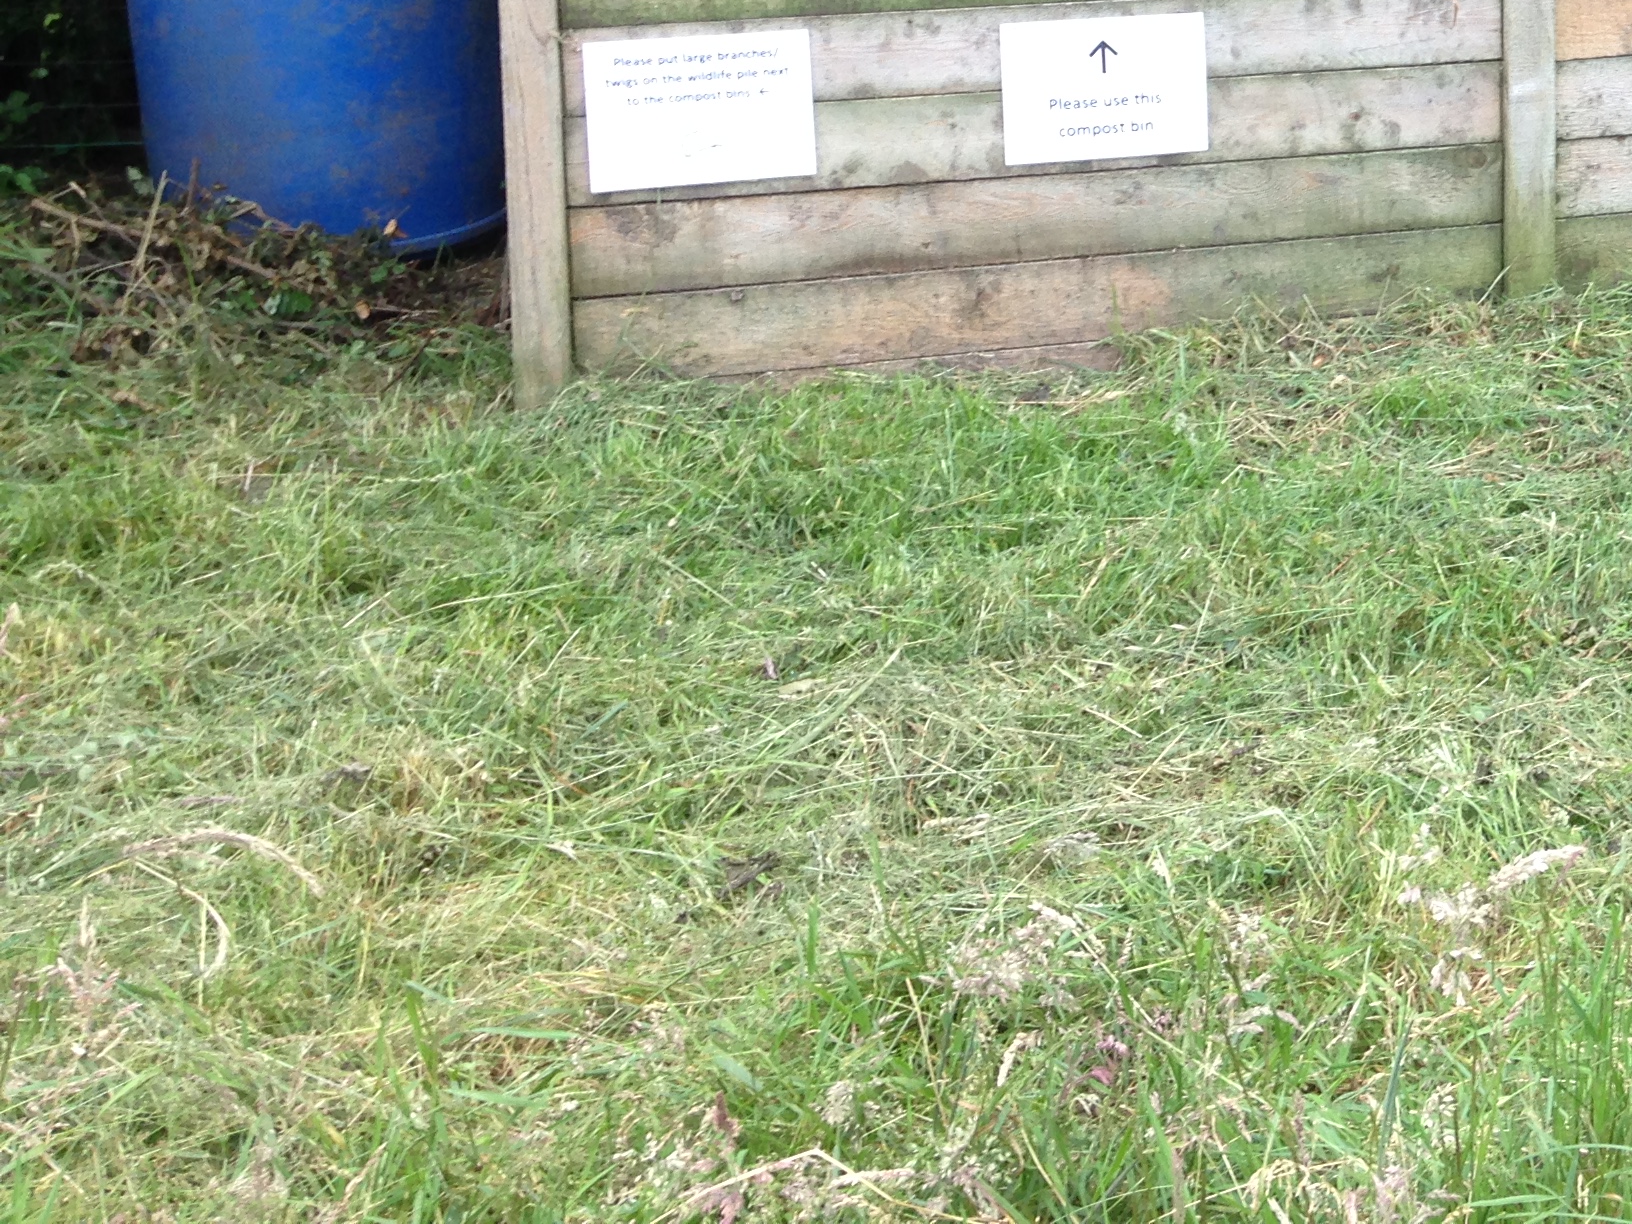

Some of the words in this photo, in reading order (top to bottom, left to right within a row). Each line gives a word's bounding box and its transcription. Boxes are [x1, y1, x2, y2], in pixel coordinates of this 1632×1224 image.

[613, 56, 654, 67] Please
[657, 55, 678, 66] put
[683, 52, 712, 63] large
[605, 77, 638, 88] twigs
[643, 76, 657, 85] on
[662, 73, 682, 83] the
[687, 70, 732, 81] wildlife
[737, 68, 758, 80] pile
[763, 67, 789, 76] next
[627, 96, 639, 106] to
[644, 94, 663, 104] the
[669, 90, 721, 103] compost
[726, 88, 750, 99] bins
[1049, 98, 1098, 110] Please
[1104, 96, 1129, 107] use
[1135, 92, 1162, 105] this
[1059, 123, 1125, 138] compost
[1131, 121, 1154, 132] bin
